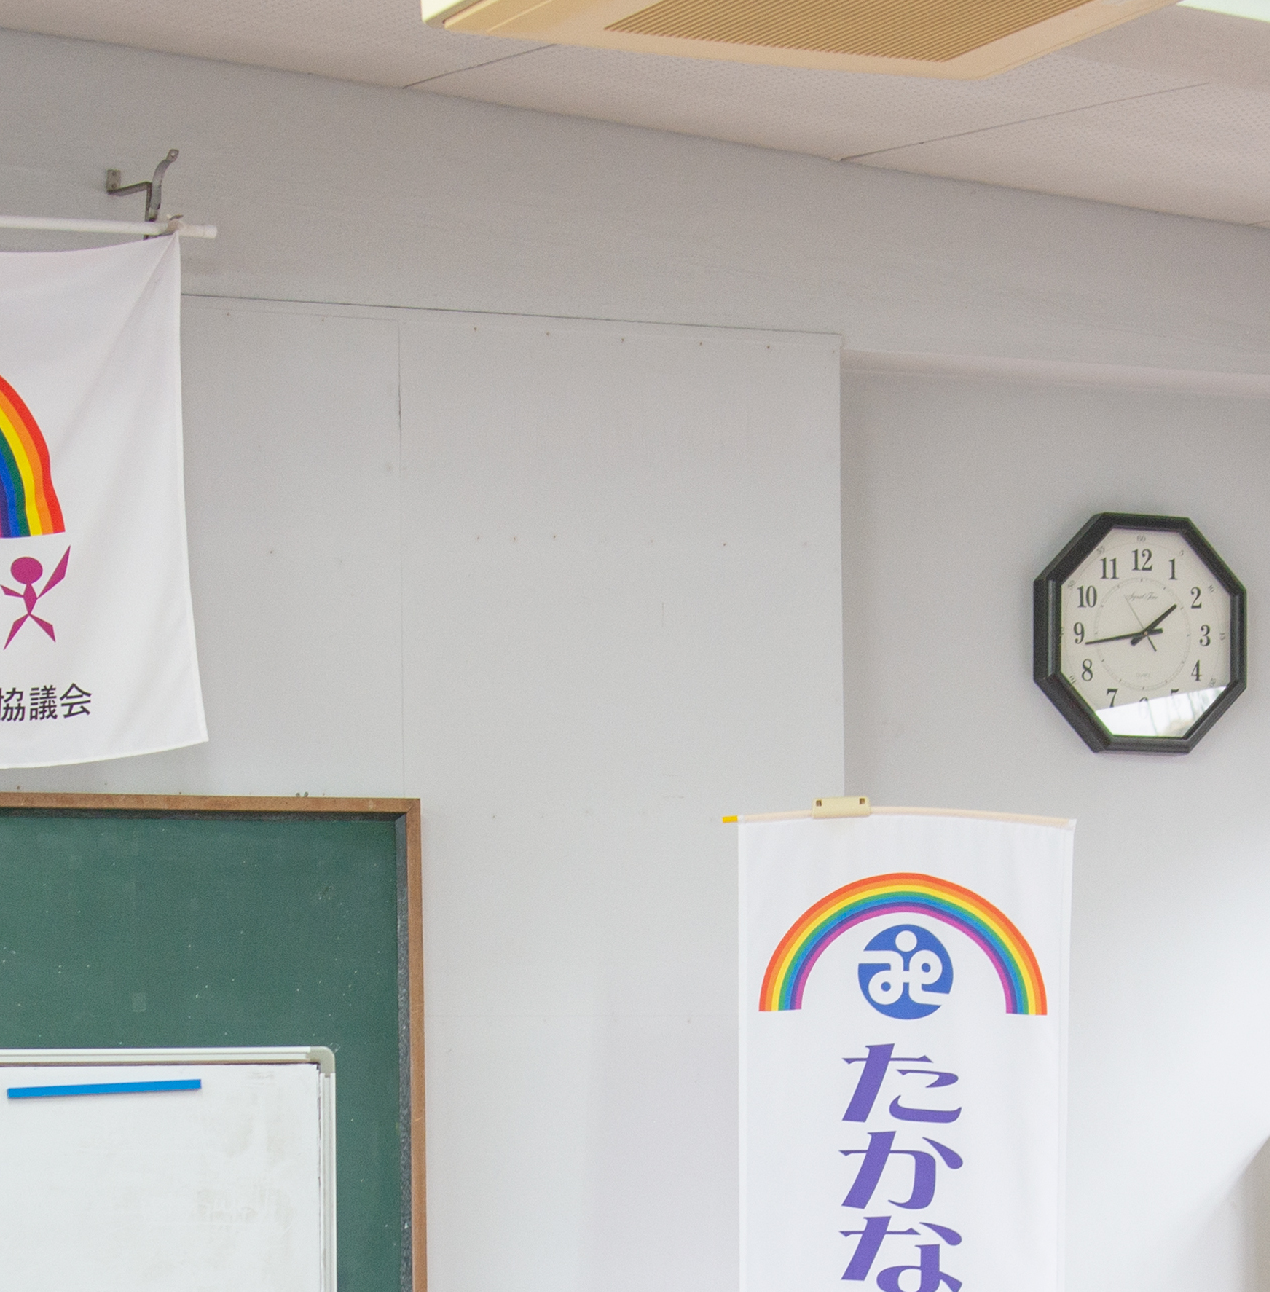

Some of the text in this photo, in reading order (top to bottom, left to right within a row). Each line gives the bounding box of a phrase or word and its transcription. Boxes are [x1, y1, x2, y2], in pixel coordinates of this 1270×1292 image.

[1100, 557, 1119, 580] 11
[1132, 548, 1153, 571] 12
[1168, 558, 1178, 580] 1
[1077, 585, 1097, 608] 10
[1191, 586, 1202, 609] 2
[1074, 621, 1085, 644] 9
[1199, 624, 1211, 646] 3
[1081, 658, 1094, 682] 8
[1191, 659, 1203, 682] 4
[1106, 688, 1118, 709] 7
